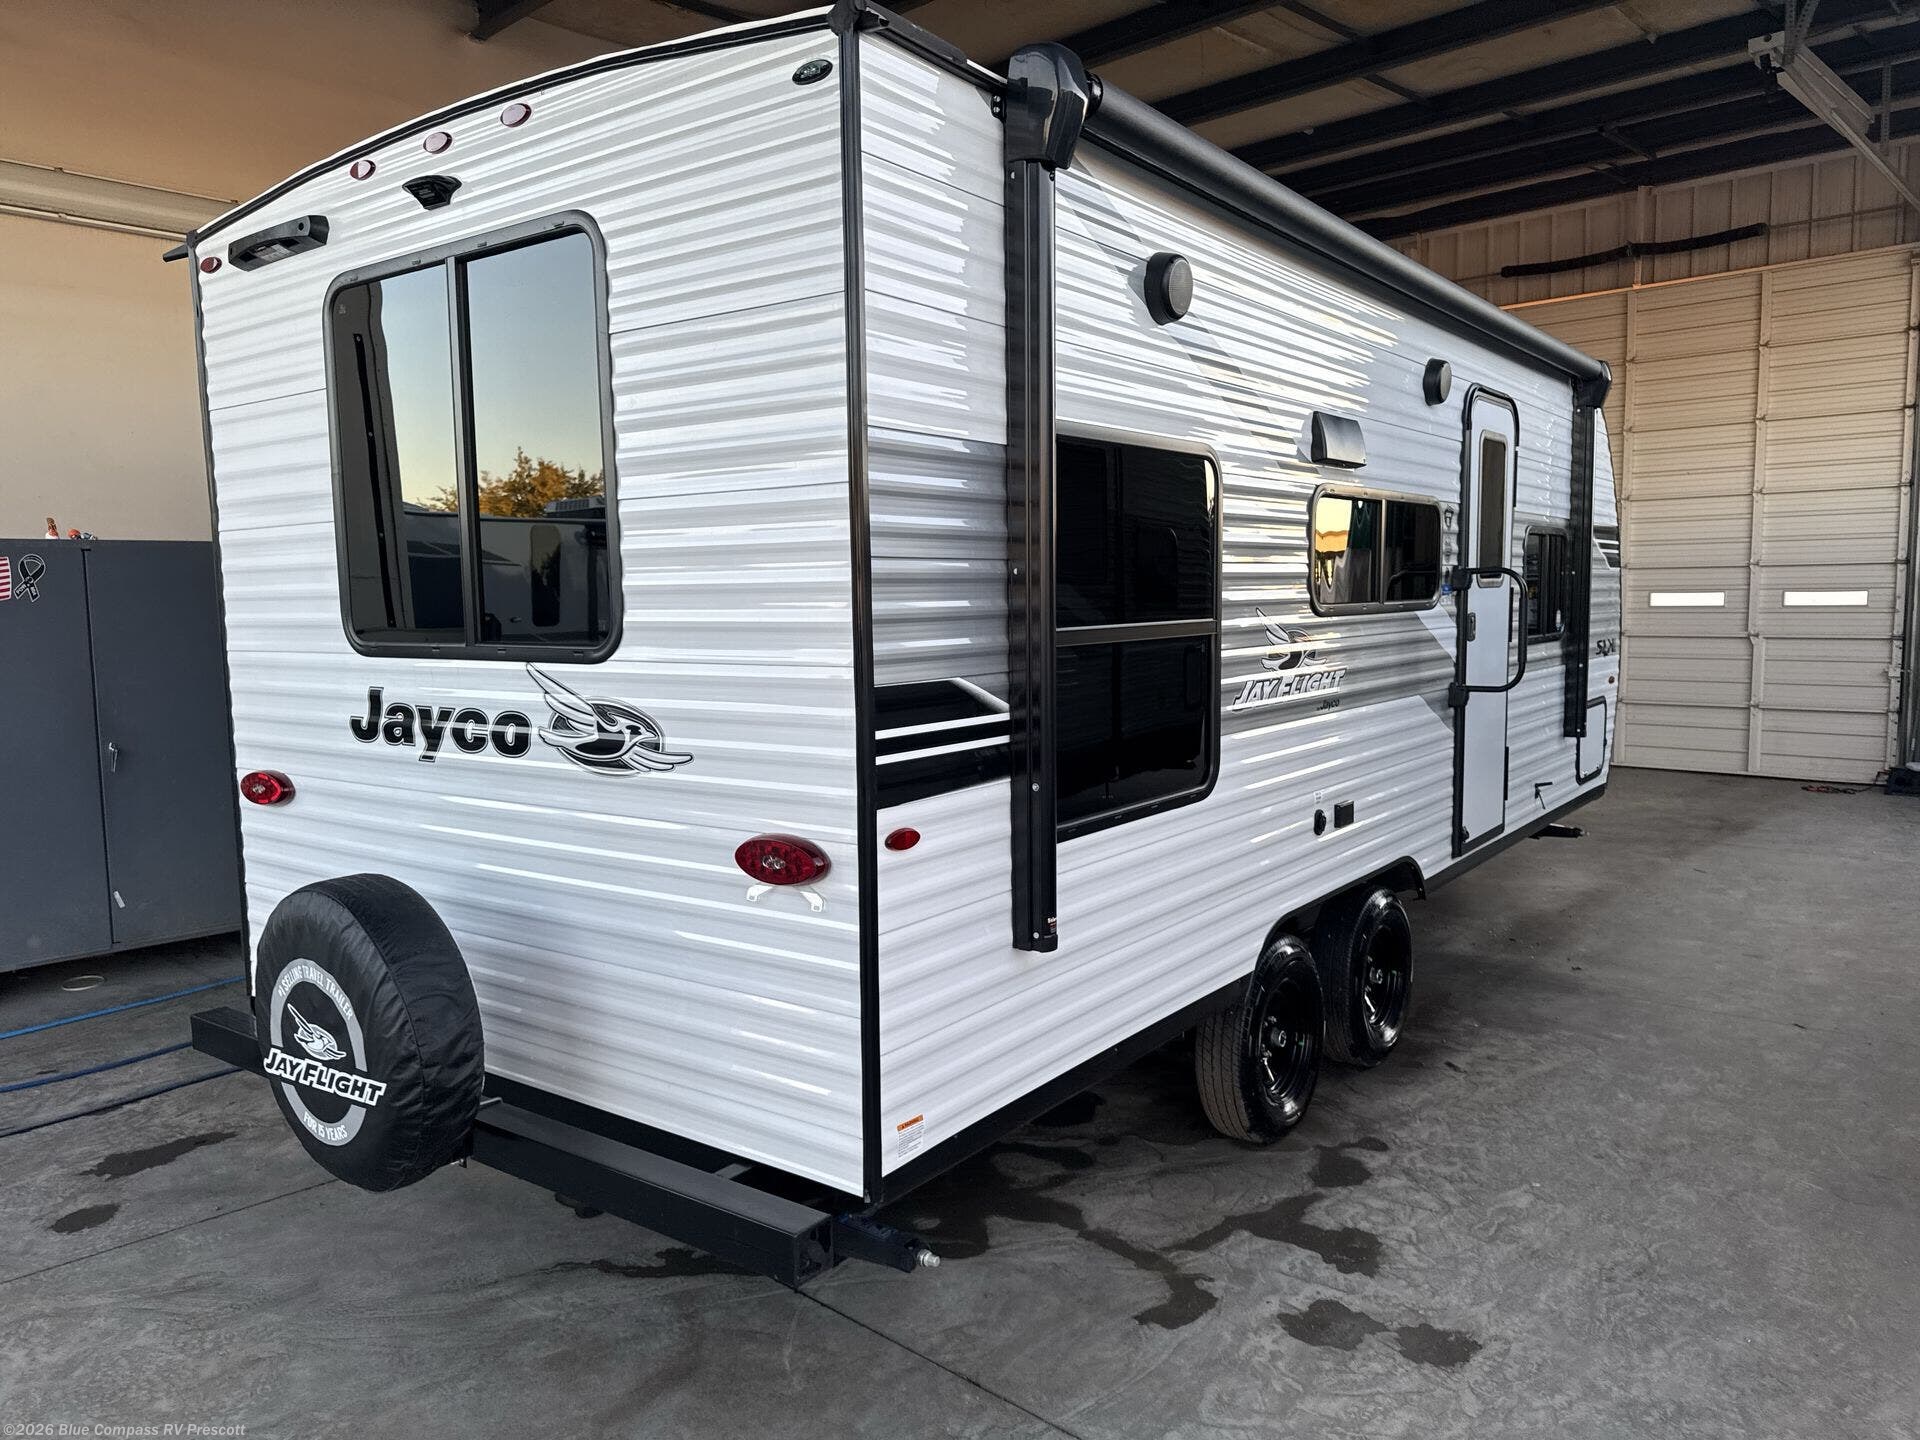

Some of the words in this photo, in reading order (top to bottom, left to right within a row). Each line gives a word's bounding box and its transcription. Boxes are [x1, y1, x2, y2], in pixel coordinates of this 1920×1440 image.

[350, 686, 532, 763] Jayco
[281, 965, 303, 992] SELLING
[302, 964, 324, 987] TRAVEL
[326, 978, 353, 1020] TRAILER
[303, 1111, 318, 1134] FOR
[317, 1123, 326, 1138] 15
[325, 1124, 348, 1141] YEARS
